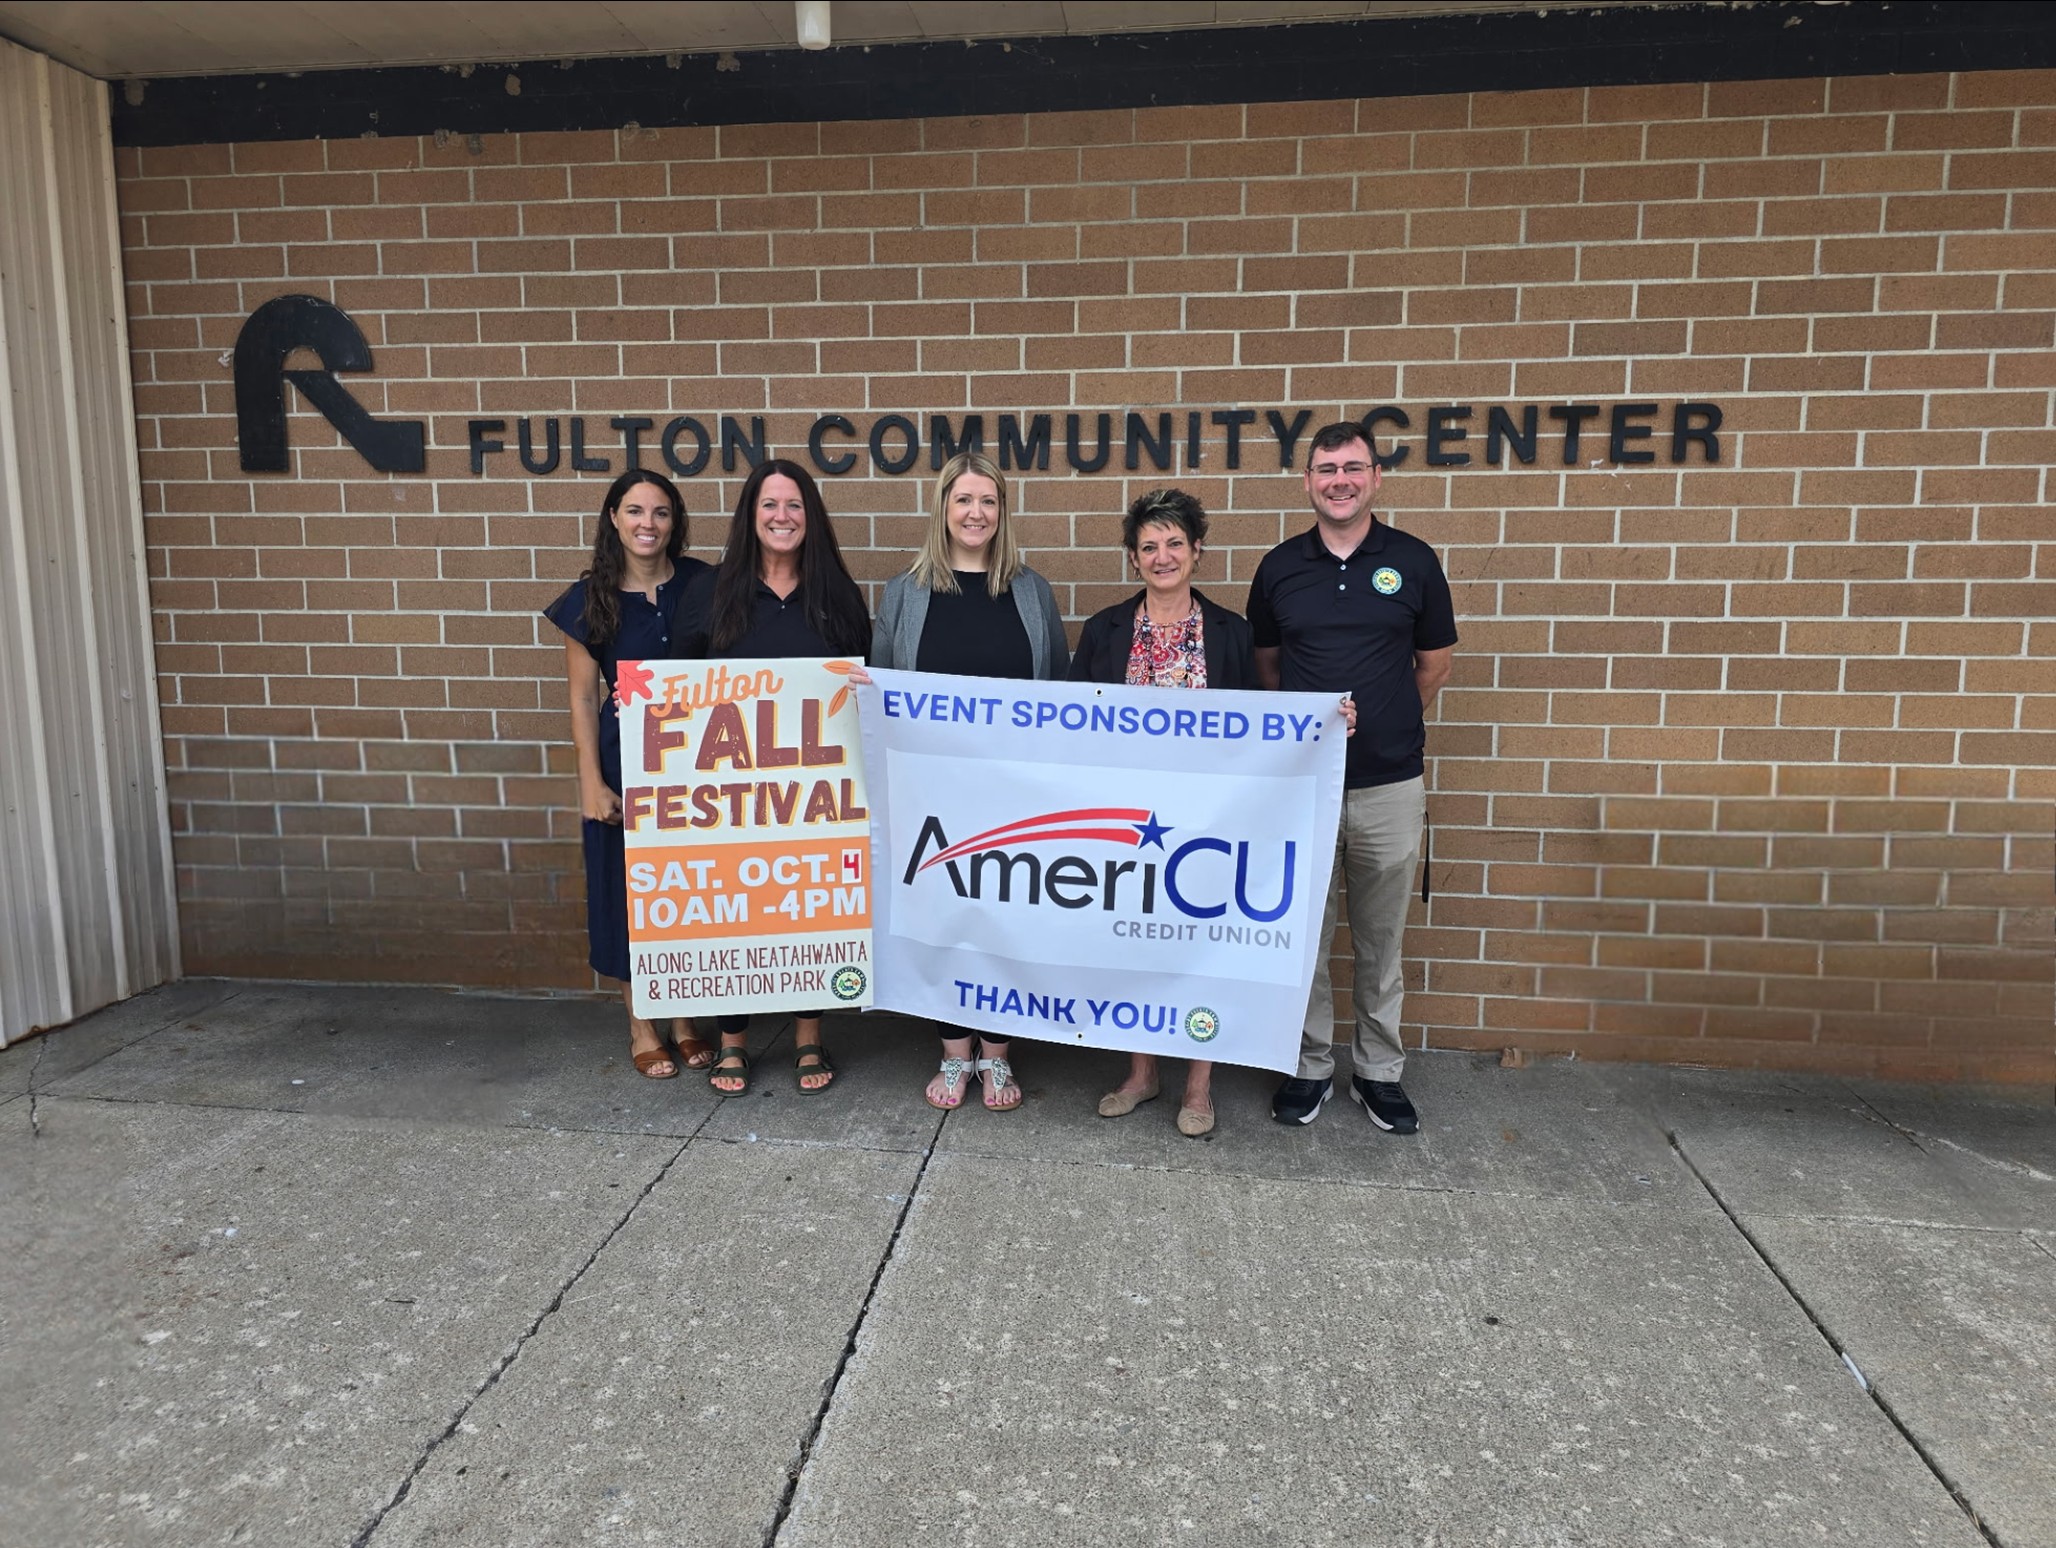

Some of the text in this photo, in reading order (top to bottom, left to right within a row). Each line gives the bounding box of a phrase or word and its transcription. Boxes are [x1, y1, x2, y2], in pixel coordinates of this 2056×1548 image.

[469, 403, 1724, 477] FULTON COMMUNITY CENTER
[650, 664, 784, 718] Fulton
[883, 689, 1323, 743] EVENT SPONSORED BY:
[642, 698, 846, 773] FALL
[624, 778, 871, 832] FESTIVAL
[629, 853, 860, 893] SAT. OCT. 4
[903, 812, 1296, 923] AmeriCU
[632, 892, 749, 930] 10AM
[1112, 919, 1292, 950] CREDIT UNION
[636, 941, 868, 976] ALONG LAKE NEATAHWANTA
[648, 979, 662, 1001] &
[668, 972, 775, 1000] RECREATION
[781, 970, 827, 993] PARK
[954, 979, 1077, 1025] THANK
[1086, 998, 1178, 1036] YOU!
